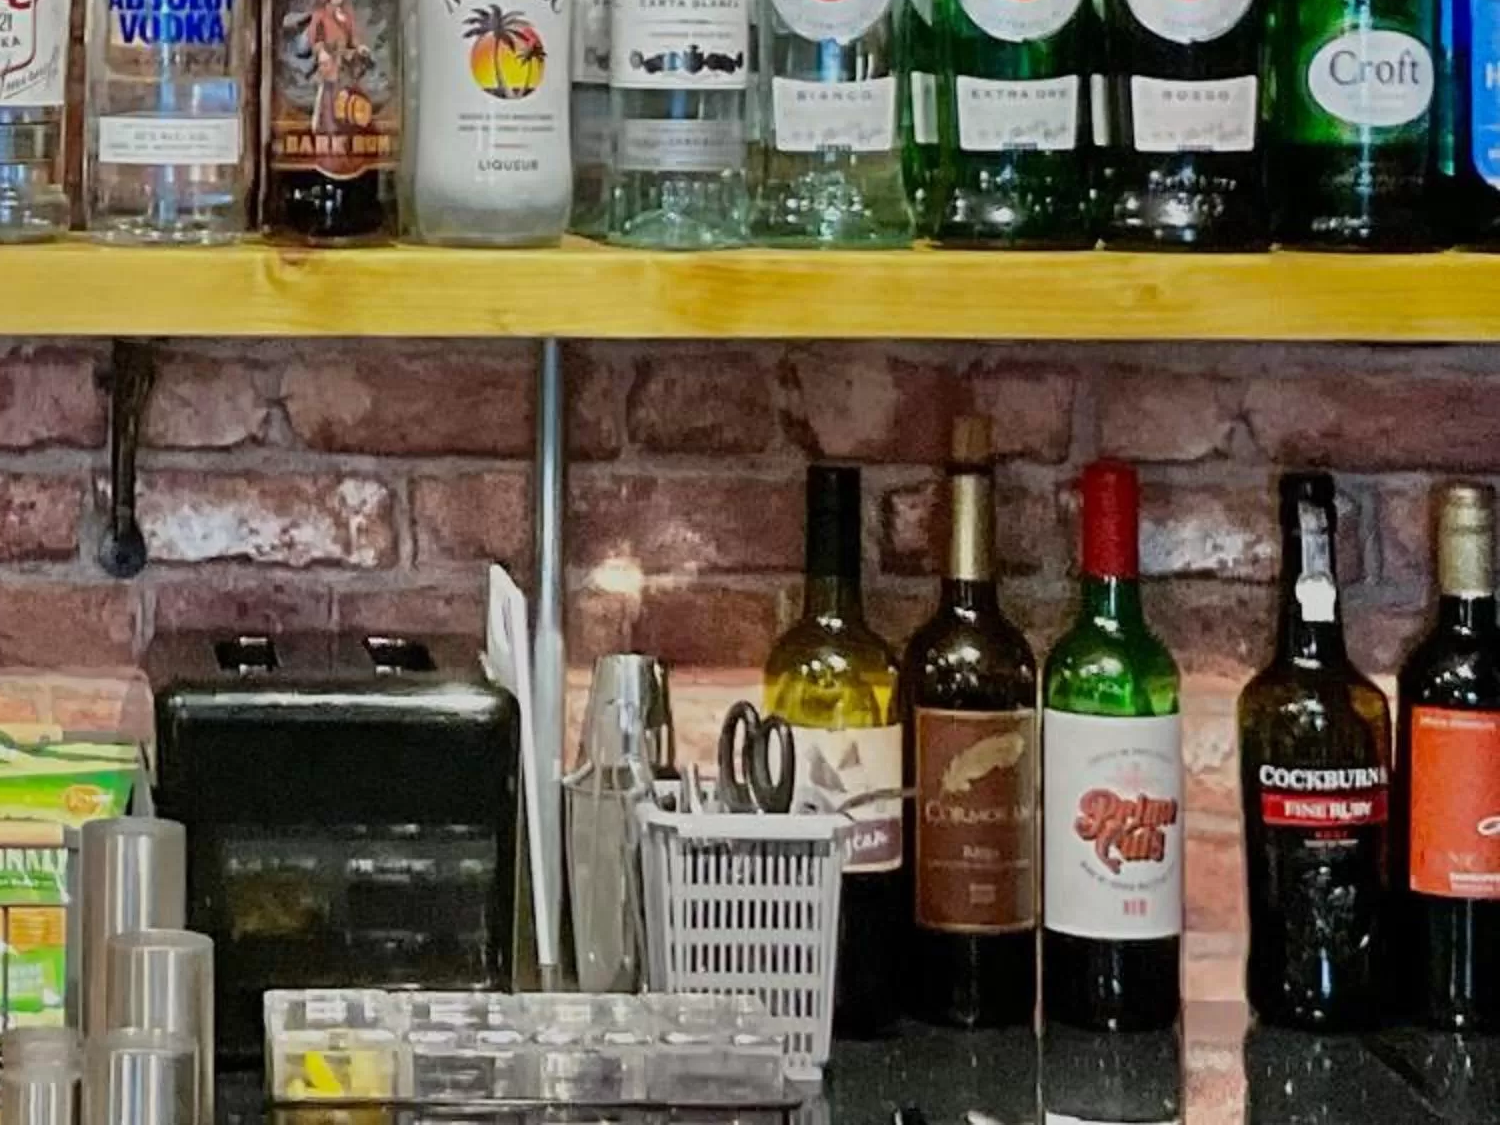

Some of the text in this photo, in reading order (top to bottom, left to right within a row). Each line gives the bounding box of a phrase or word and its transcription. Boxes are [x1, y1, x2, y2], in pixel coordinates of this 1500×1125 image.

[119, 12, 227, 45] VODKA
[1329, 48, 1420, 86] Croft
[286, 134, 349, 155] DARK
